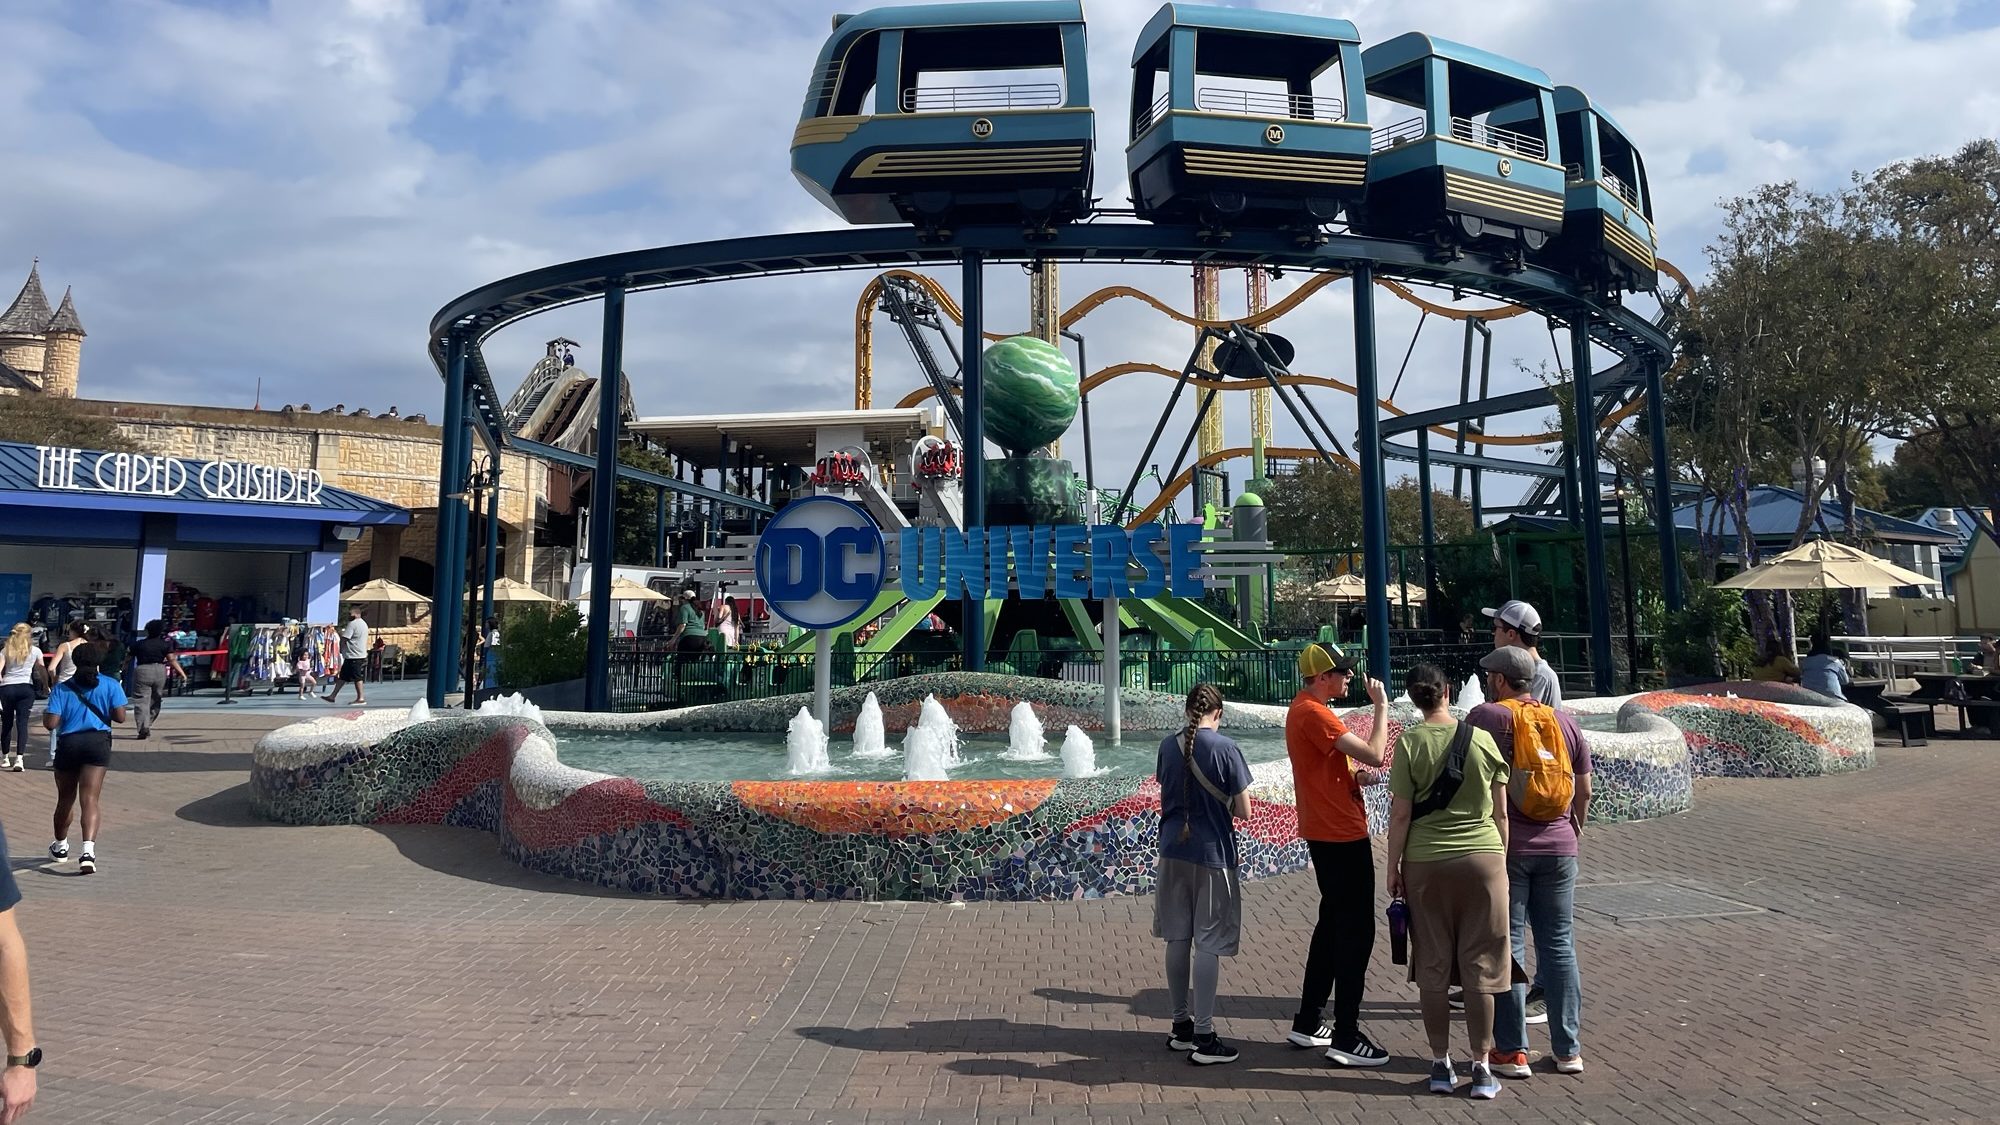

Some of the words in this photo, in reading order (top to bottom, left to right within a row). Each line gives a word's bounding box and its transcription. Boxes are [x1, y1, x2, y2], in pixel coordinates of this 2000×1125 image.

[976, 123, 988, 132] M
[1270, 129, 1281, 139] M
[36, 446, 81, 489] THE
[95, 452, 186, 496] CAPED
[200, 461, 323, 505] CRUSADER
[759, 526, 883, 602] DC
[901, 523, 1204, 601] UNIVERSE
